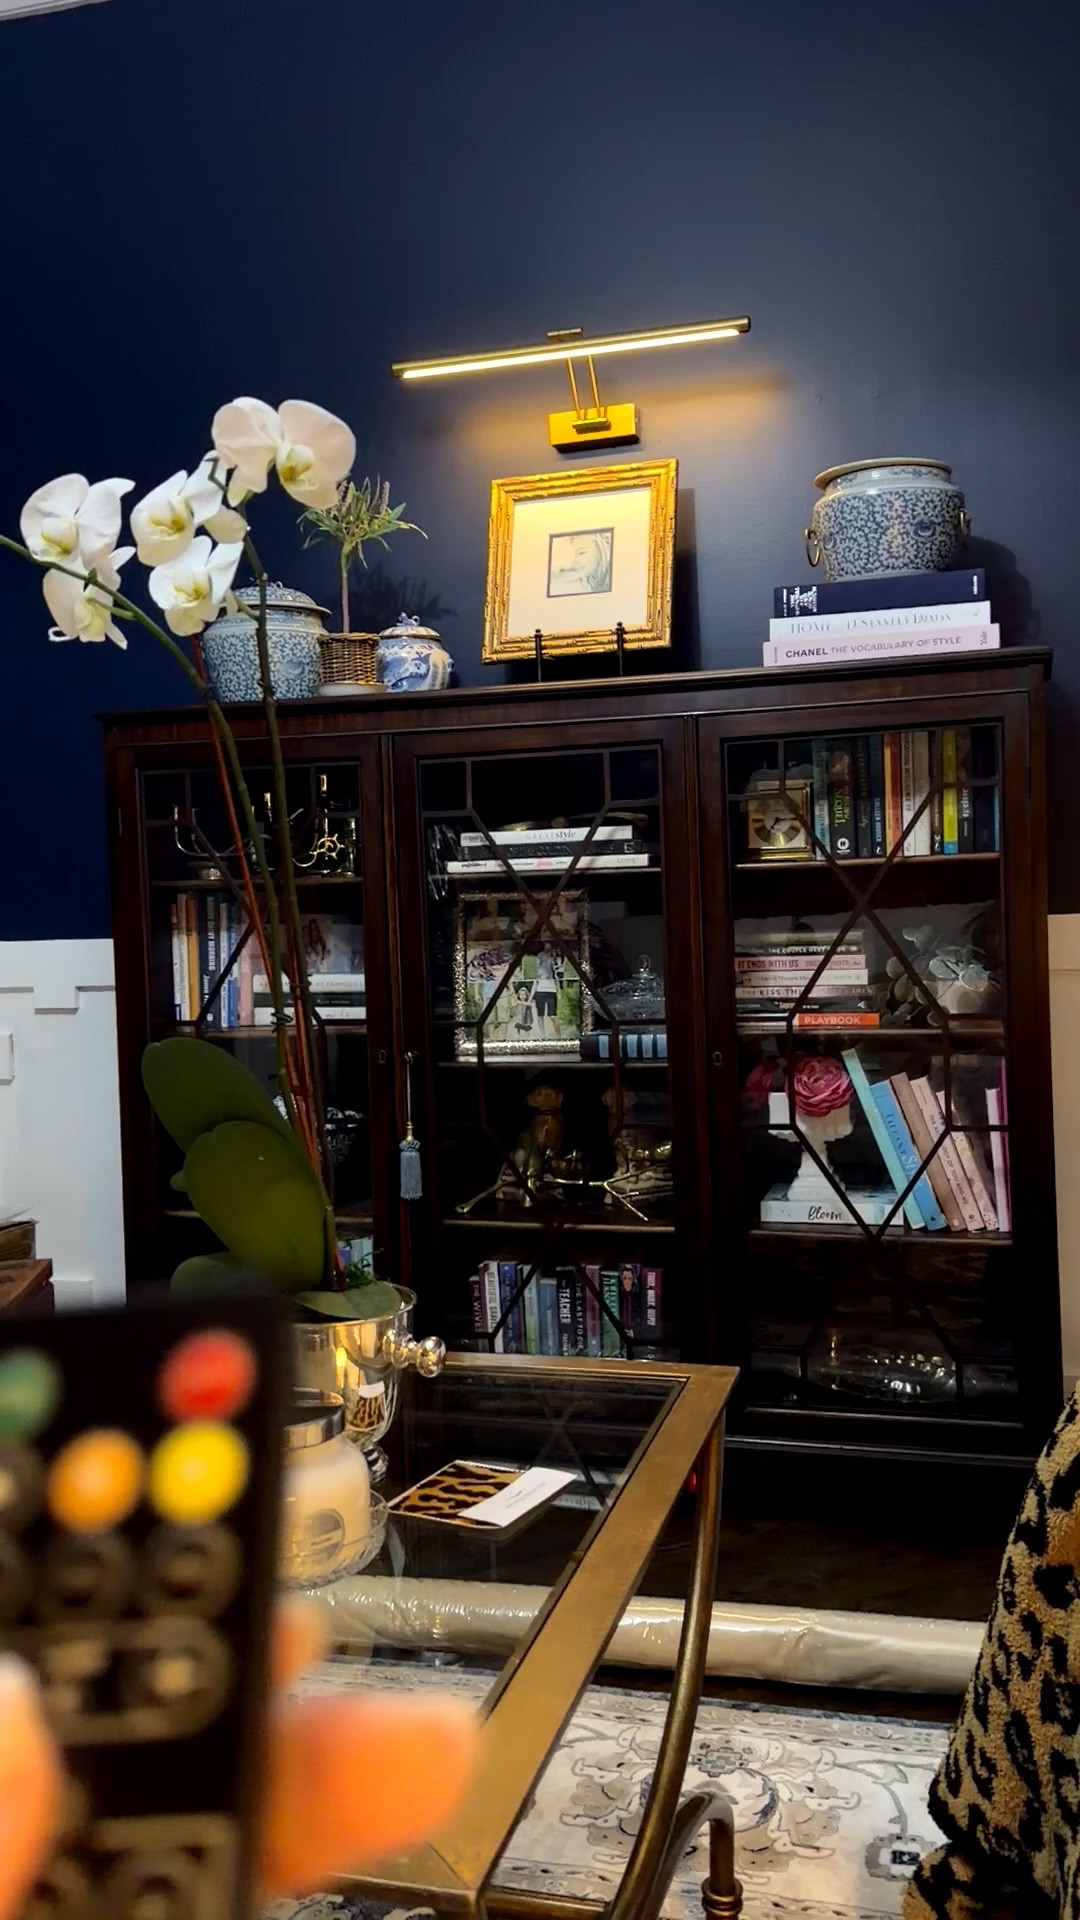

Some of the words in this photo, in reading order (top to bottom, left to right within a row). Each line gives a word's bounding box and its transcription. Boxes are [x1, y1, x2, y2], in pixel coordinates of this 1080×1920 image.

[791, 621, 830, 634] HOME
[785, 647, 828, 659] CHANEL
[831, 645, 849, 654] THE
[851, 639, 914, 653] VOCABULARY
[916, 639, 930, 647] OF
[933, 636, 962, 645] STYLE
[208, 940, 216, 971] MORNING
[768, 960, 787, 969] WITH
[789, 959, 800, 968] US
[804, 1016, 861, 1025] PLAYBOOK
[885, 1113, 906, 1155] TIFFANY
[808, 1205, 842, 1221] Bloom
[559, 1289, 571, 1324] TEACHER
[577, 1325, 583, 1335] TO
